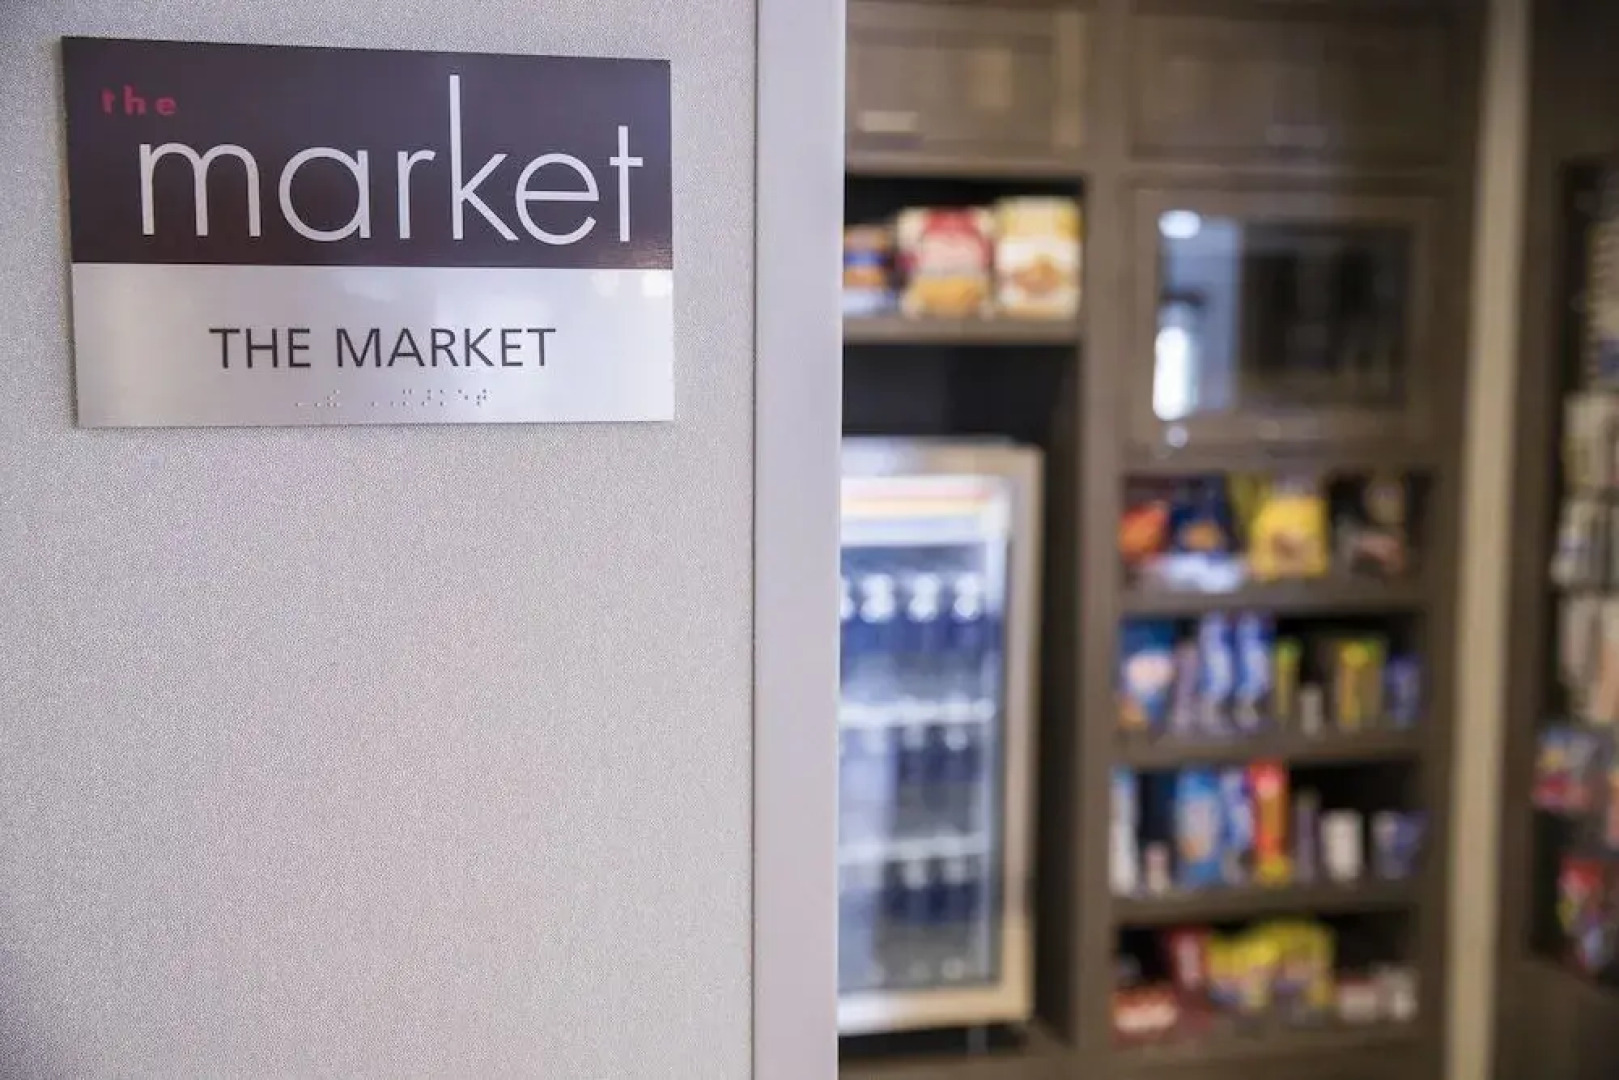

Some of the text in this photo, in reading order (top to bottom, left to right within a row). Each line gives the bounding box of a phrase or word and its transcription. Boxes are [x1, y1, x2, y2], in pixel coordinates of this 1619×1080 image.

[101, 86, 178, 117] the
[139, 74, 644, 246] market
[209, 327, 557, 368] THE MARKET
